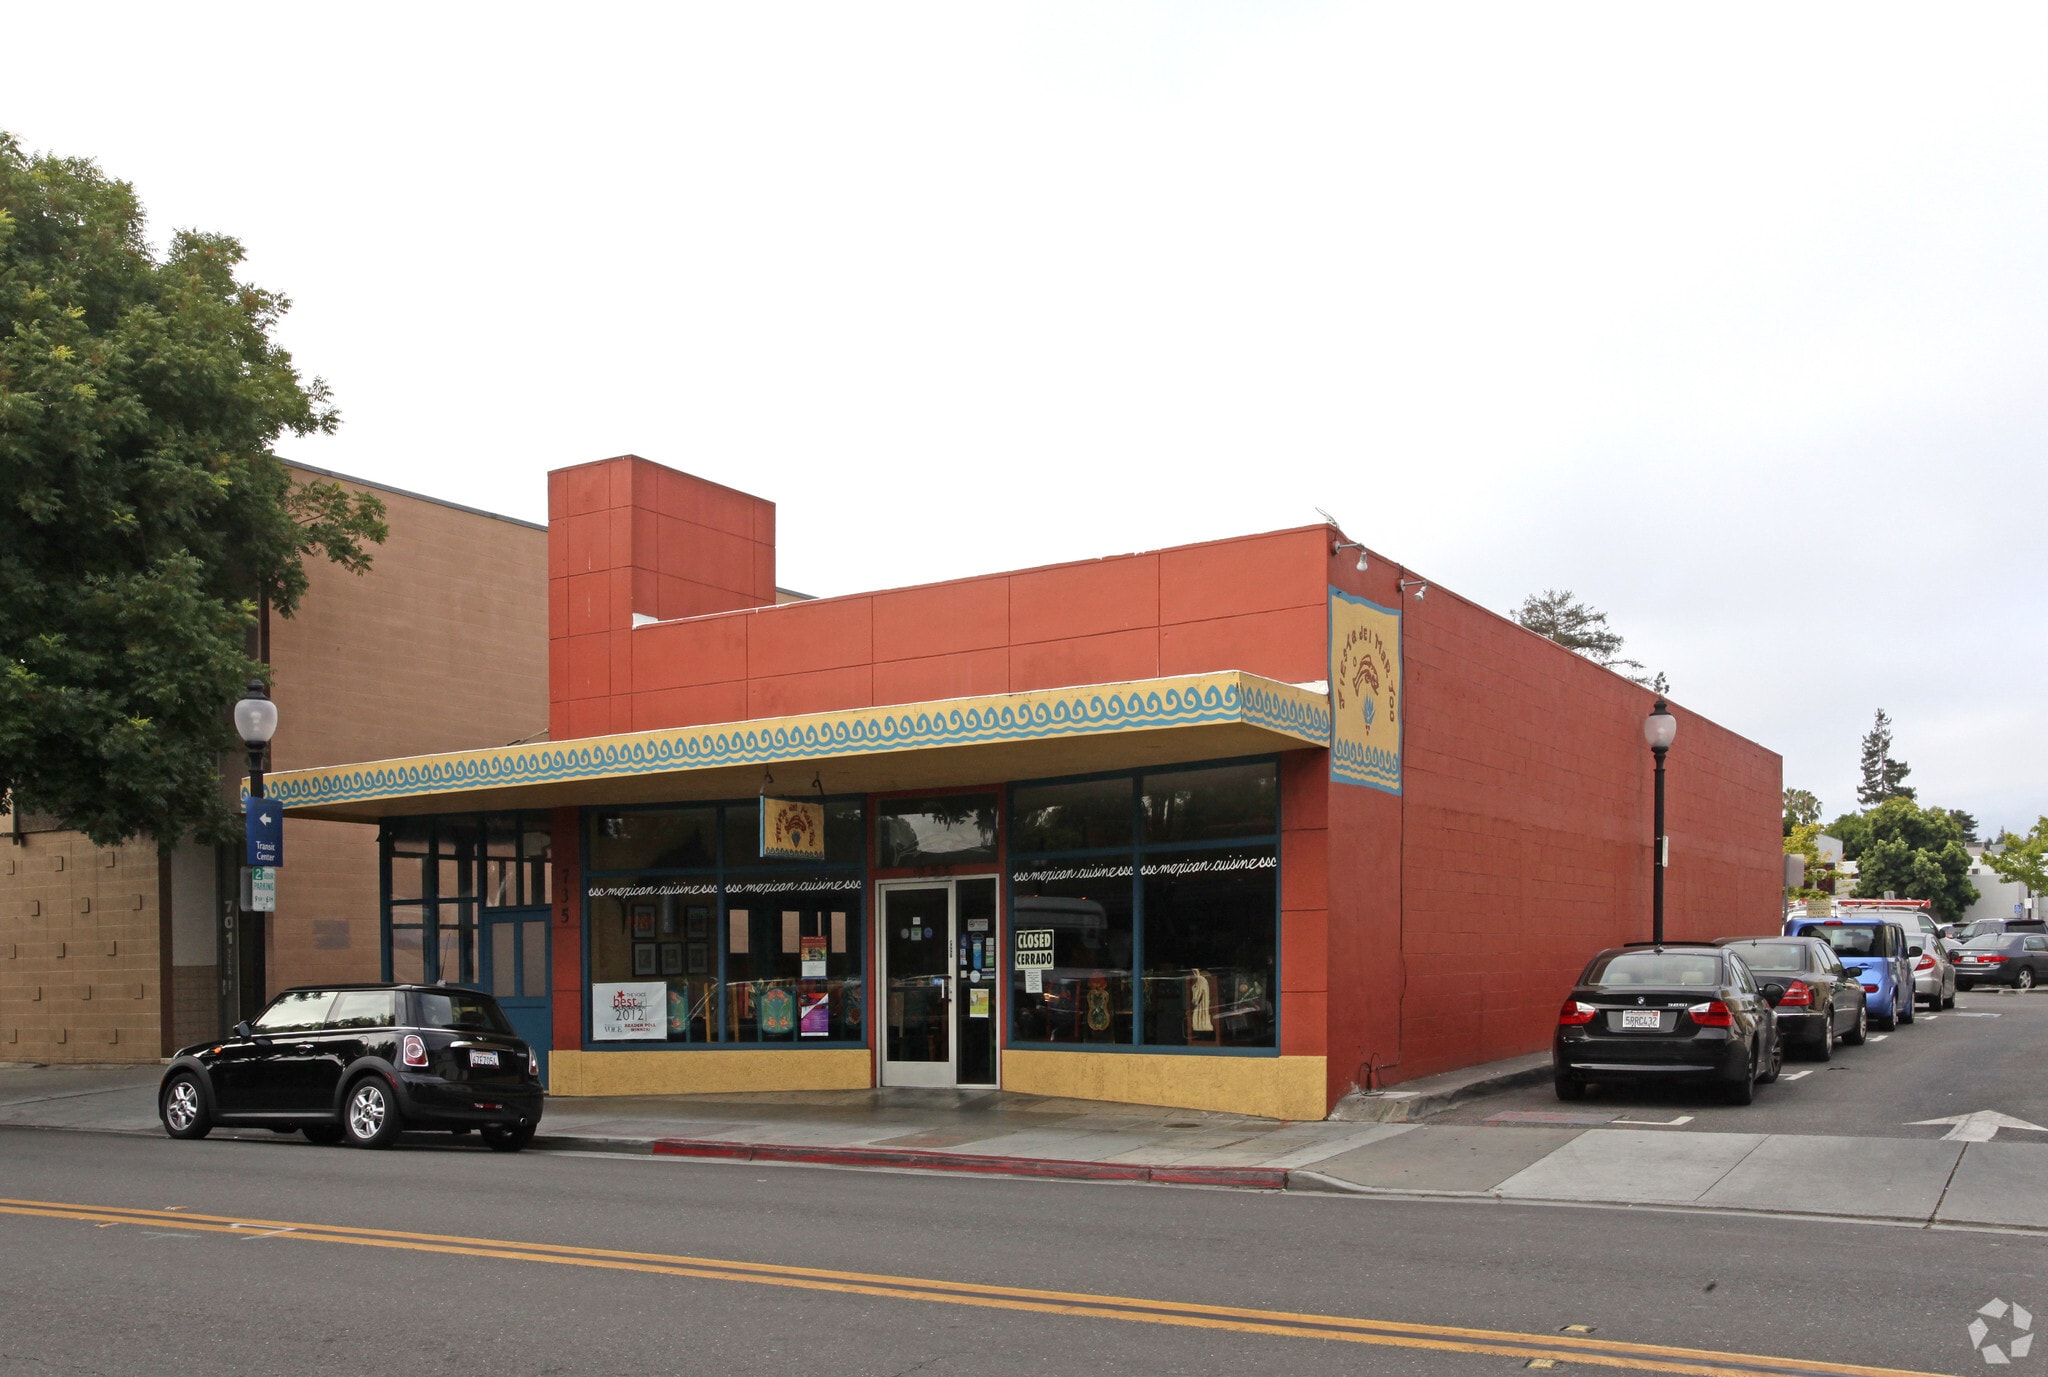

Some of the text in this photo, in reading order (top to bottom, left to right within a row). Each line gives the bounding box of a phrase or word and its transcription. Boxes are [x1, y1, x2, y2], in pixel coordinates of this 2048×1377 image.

[256, 841, 275, 851] Transit
[256, 852, 275, 861] Center
[1158, 855, 1259, 877] mexican cuisine
[255, 869, 261, 880] 2
[1030, 864, 1121, 883] mexican cuisine
[254, 881, 275, 892] PARKING
[607, 881, 701, 899] mexican cuisine
[744, 877, 843, 895] mexican cuisine
[561, 868, 569, 923] 735
[224, 900, 234, 945] 701
[1018, 933, 1051, 949] CLOSED
[1016, 952, 1052, 965] CERRADO
[613, 995, 637, 1008] best
[615, 1009, 644, 1021] 2012
